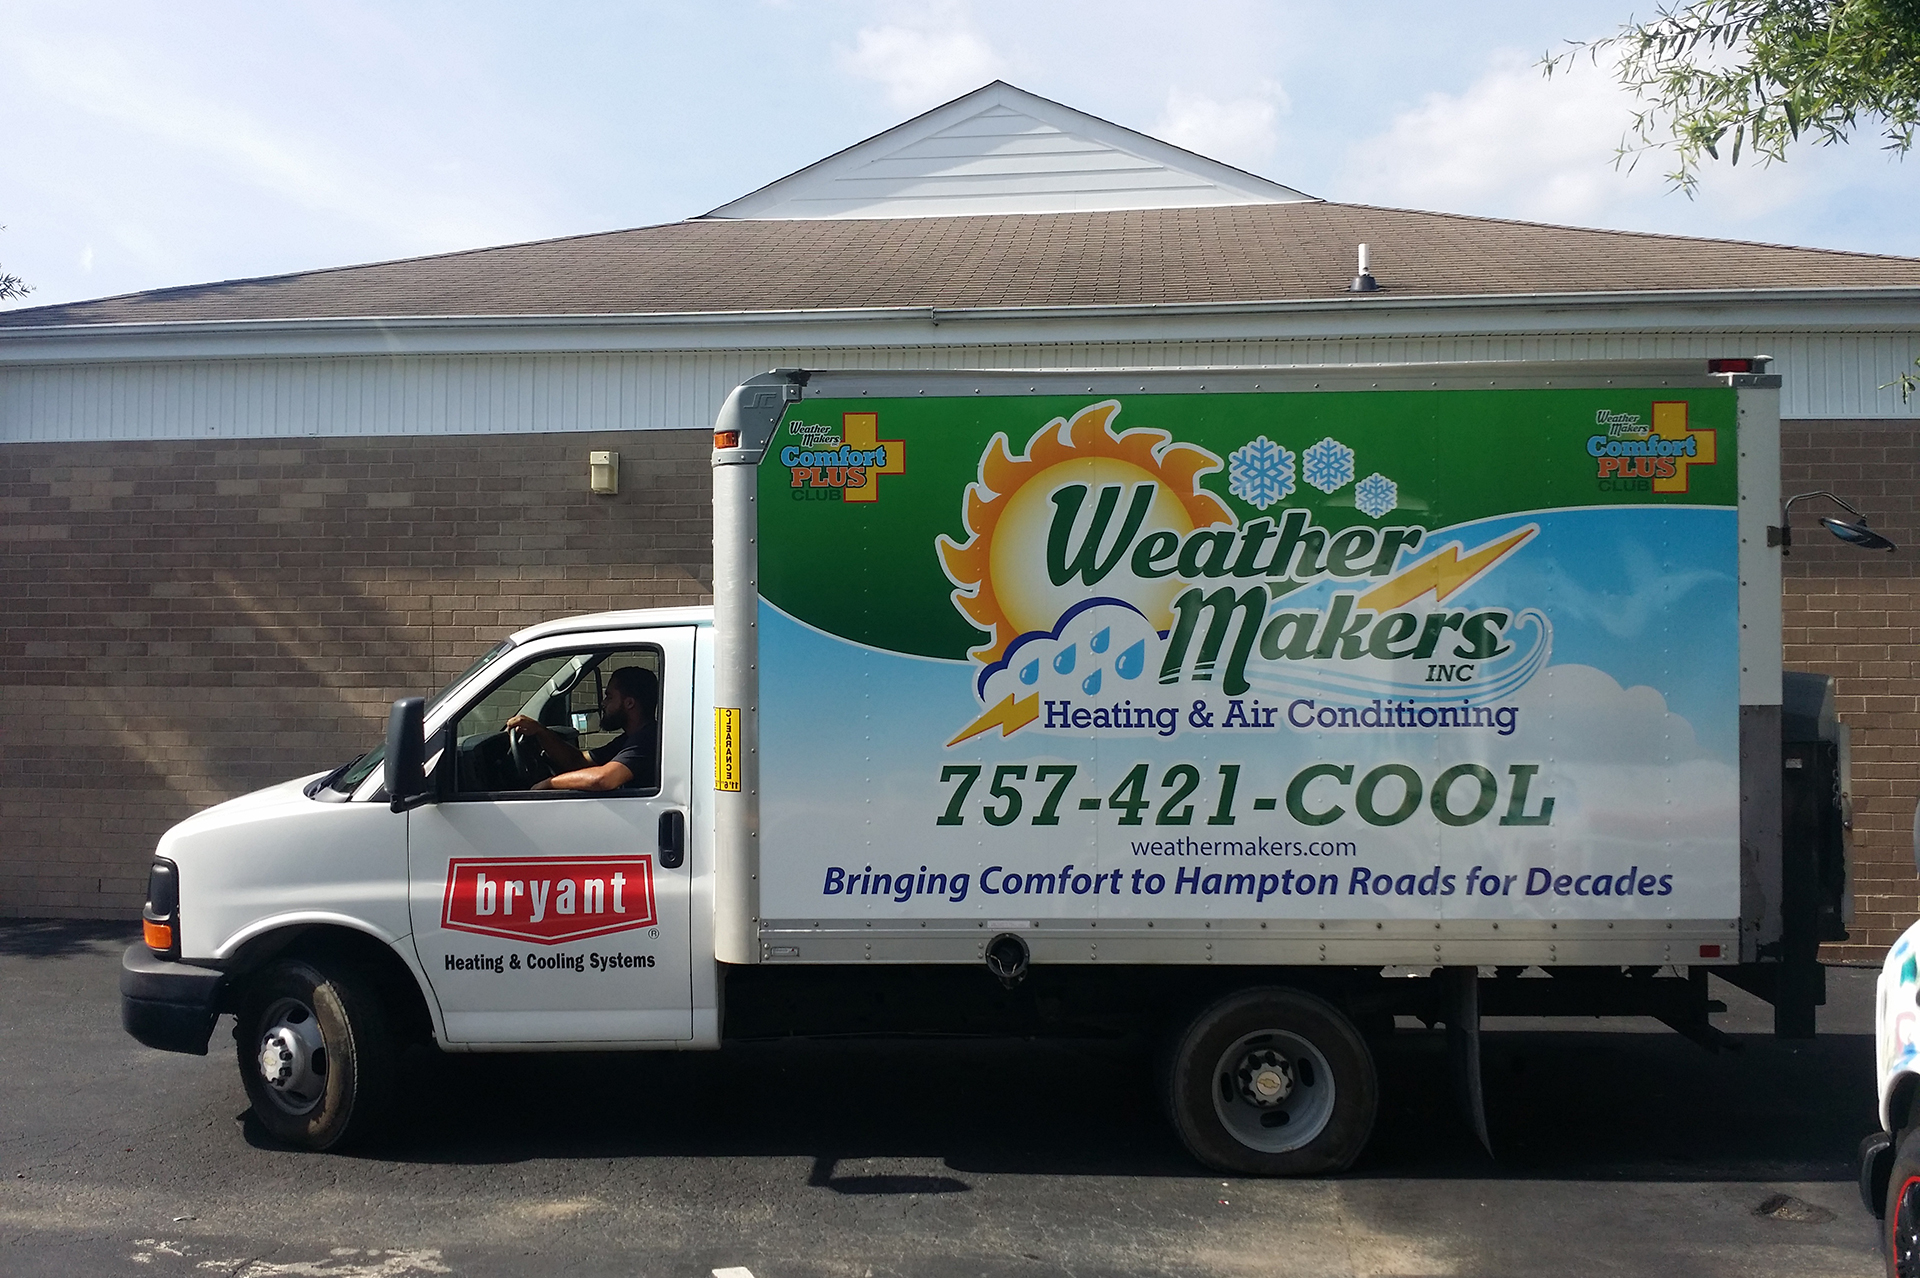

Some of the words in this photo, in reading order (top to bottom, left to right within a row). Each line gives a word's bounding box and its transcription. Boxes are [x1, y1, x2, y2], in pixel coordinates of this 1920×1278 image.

[790, 421, 831, 435] Weather
[1597, 410, 1639, 424] Weather
[802, 433, 840, 448] Makers
[1609, 423, 1648, 437] Makers
[1587, 434, 1696, 456] Comfort
[781, 446, 886, 467] Comfort
[1598, 456, 1676, 478] PLUS
[791, 467, 866, 487] PLUS
[1598, 480, 1650, 492] CLUB
[792, 489, 841, 501] CLUB
[1046, 484, 1423, 588] Weather
[1158, 585, 1512, 697] Makers
[1425, 664, 1475, 683] INC
[1044, 699, 1180, 737] Heating
[1188, 700, 1214, 729] &
[1222, 699, 1279, 729] Air
[1288, 699, 1519, 737] Conditioning
[936, 763, 1556, 827] 757-421-COOL
[1131, 835, 1357, 857] weathermakers.com
[823, 865, 970, 902] Bringing
[980, 864, 1123, 896] Comfort
[1131, 868, 1166, 895] to
[1175, 866, 1339, 902] Hampton
[1348, 865, 1457, 896] Roads
[1465, 865, 1517, 896] for
[1525, 865, 1674, 897] Decades
[475, 872, 627, 923] bryant
[444, 954, 504, 974] Heating
[509, 953, 522, 970] &
[526, 952, 585, 972] Cooling
[589, 952, 656, 972] Systems
